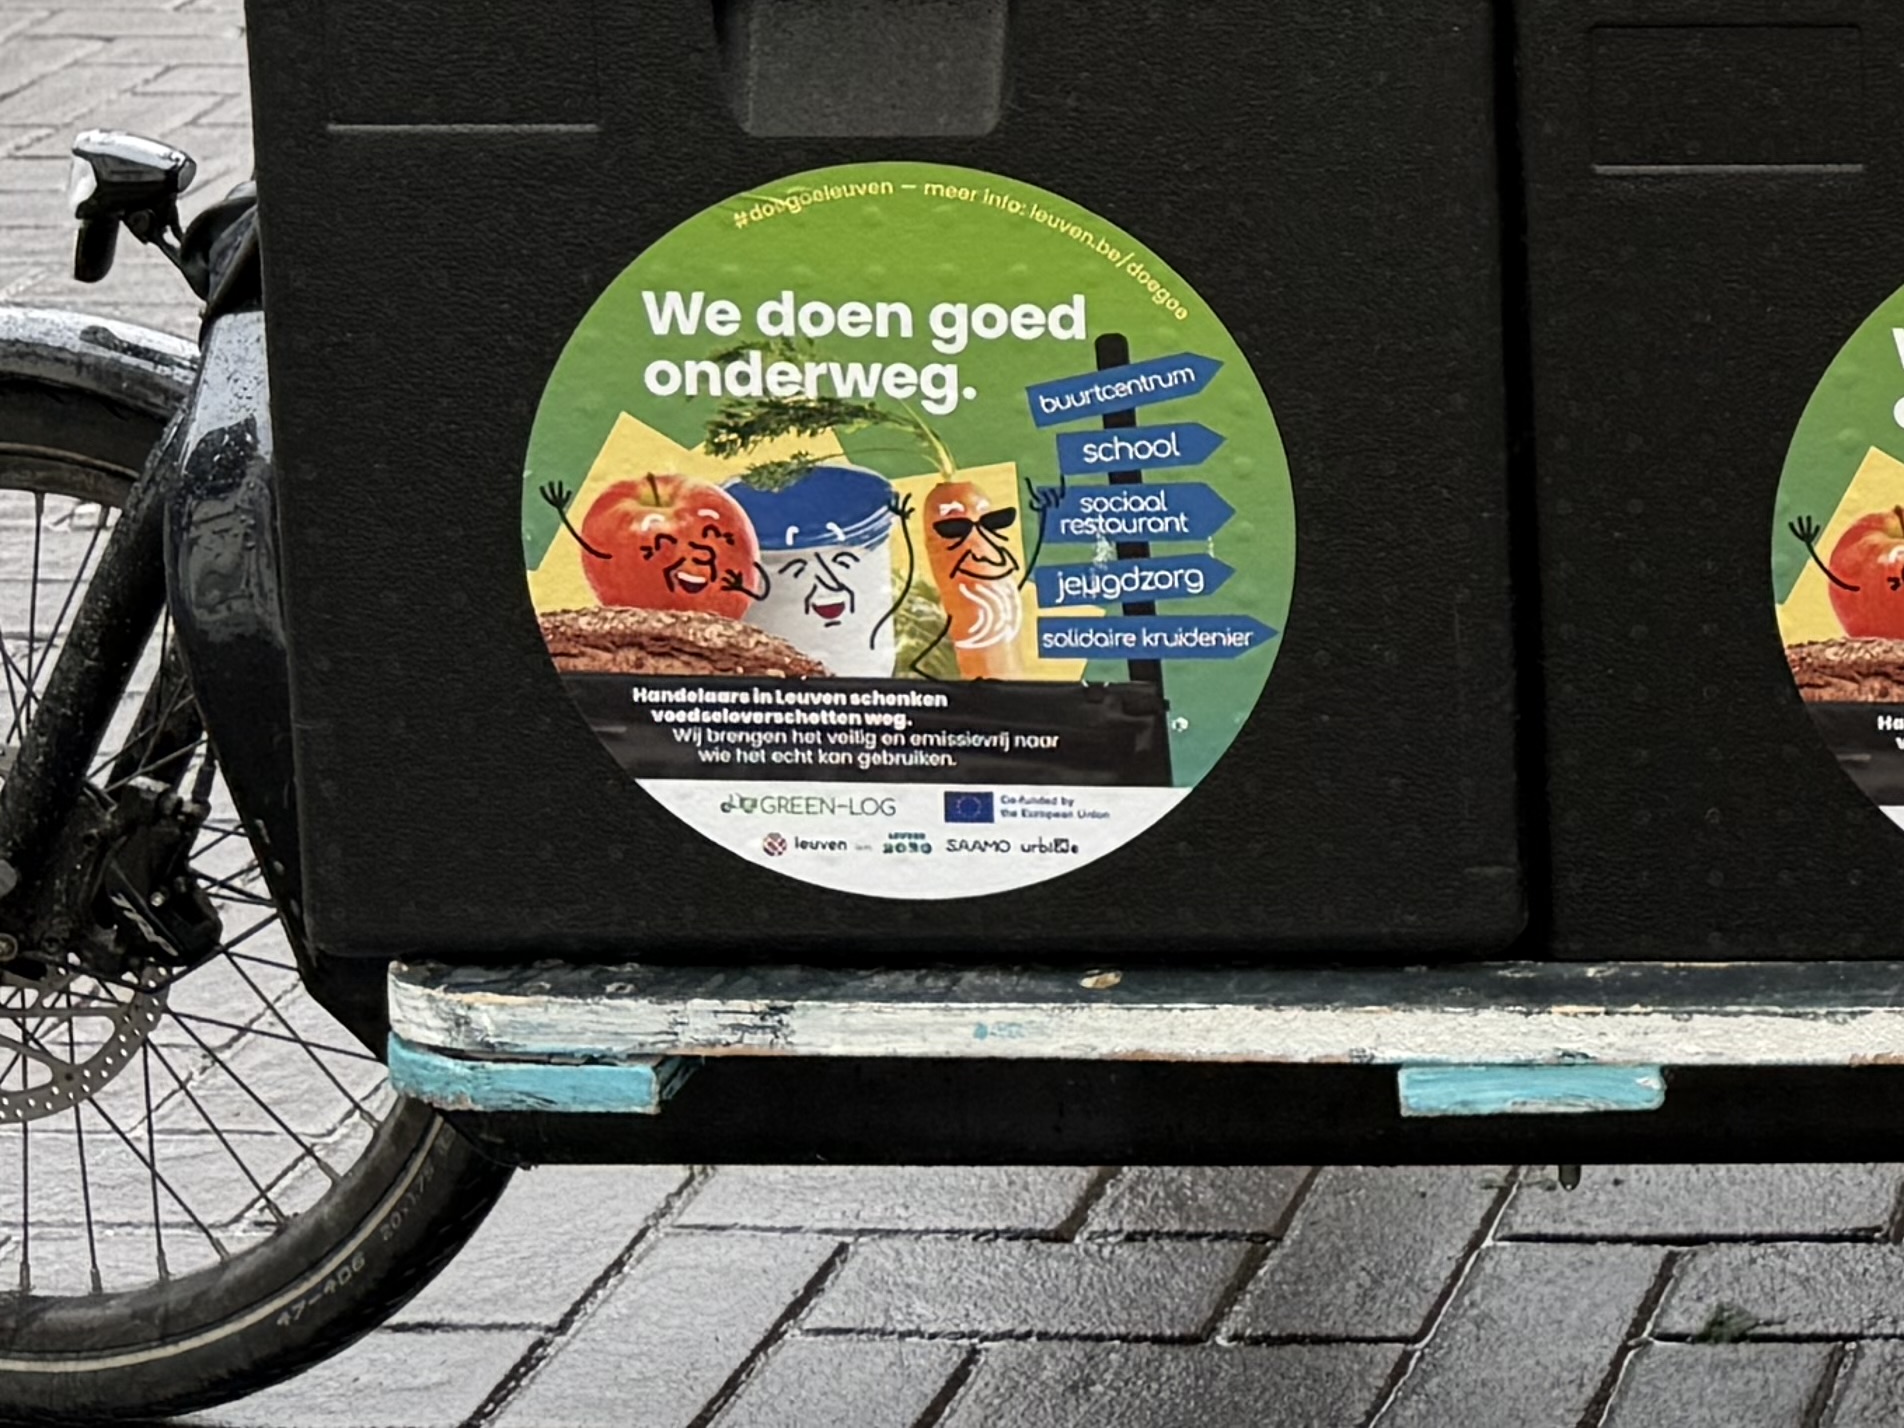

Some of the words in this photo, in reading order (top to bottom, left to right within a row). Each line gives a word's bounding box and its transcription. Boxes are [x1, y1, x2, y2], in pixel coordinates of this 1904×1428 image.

[924, 182, 977, 203] meer
[982, 188, 1026, 216] info:
[641, 290, 741, 338] We
[756, 292, 913, 340] doen
[929, 294, 1088, 355] goed
[643, 351, 978, 413] onderweg.
[1039, 365, 1196, 414] buurtcentrum
[1082, 431, 1181, 464] school
[1079, 490, 1168, 514] sociaal
[1060, 512, 1190, 535] restaurant
[1055, 565, 1205, 603] jeugdzorg
[1042, 627, 1136, 649] solidaire
[1141, 626, 1254, 648] kruidenier
[632, 687, 750, 705] Handelaars
[753, 686, 773, 705] in
[775, 689, 847, 706] Leuven
[850, 689, 949, 707] schenken
[650, 708, 863, 726] voedseloverschotten
[865, 712, 914, 731] weg.
[672, 726, 702, 747] Wij
[706, 727, 787, 748] brengen
[791, 728, 822, 745] het
[827, 729, 877, 750] veilig
[881, 732, 905, 745] en
[1014, 734, 1059, 748] naar
[698, 747, 731, 764] wie
[735, 747, 766, 764] het
[771, 748, 814, 764] echt
[818, 748, 853, 765] kan
[857, 750, 958, 770] gebruiken.
[760, 795, 897, 817] GREEN-LOG
[1000, 794, 1058, 807] Co-funded
[1061, 795, 1075, 808] by
[1000, 808, 1018, 819] the
[794, 836, 848, 851] leuven
[946, 838, 1011, 854] SAAMO
[276, 1251, 366, 1326] 47-406
